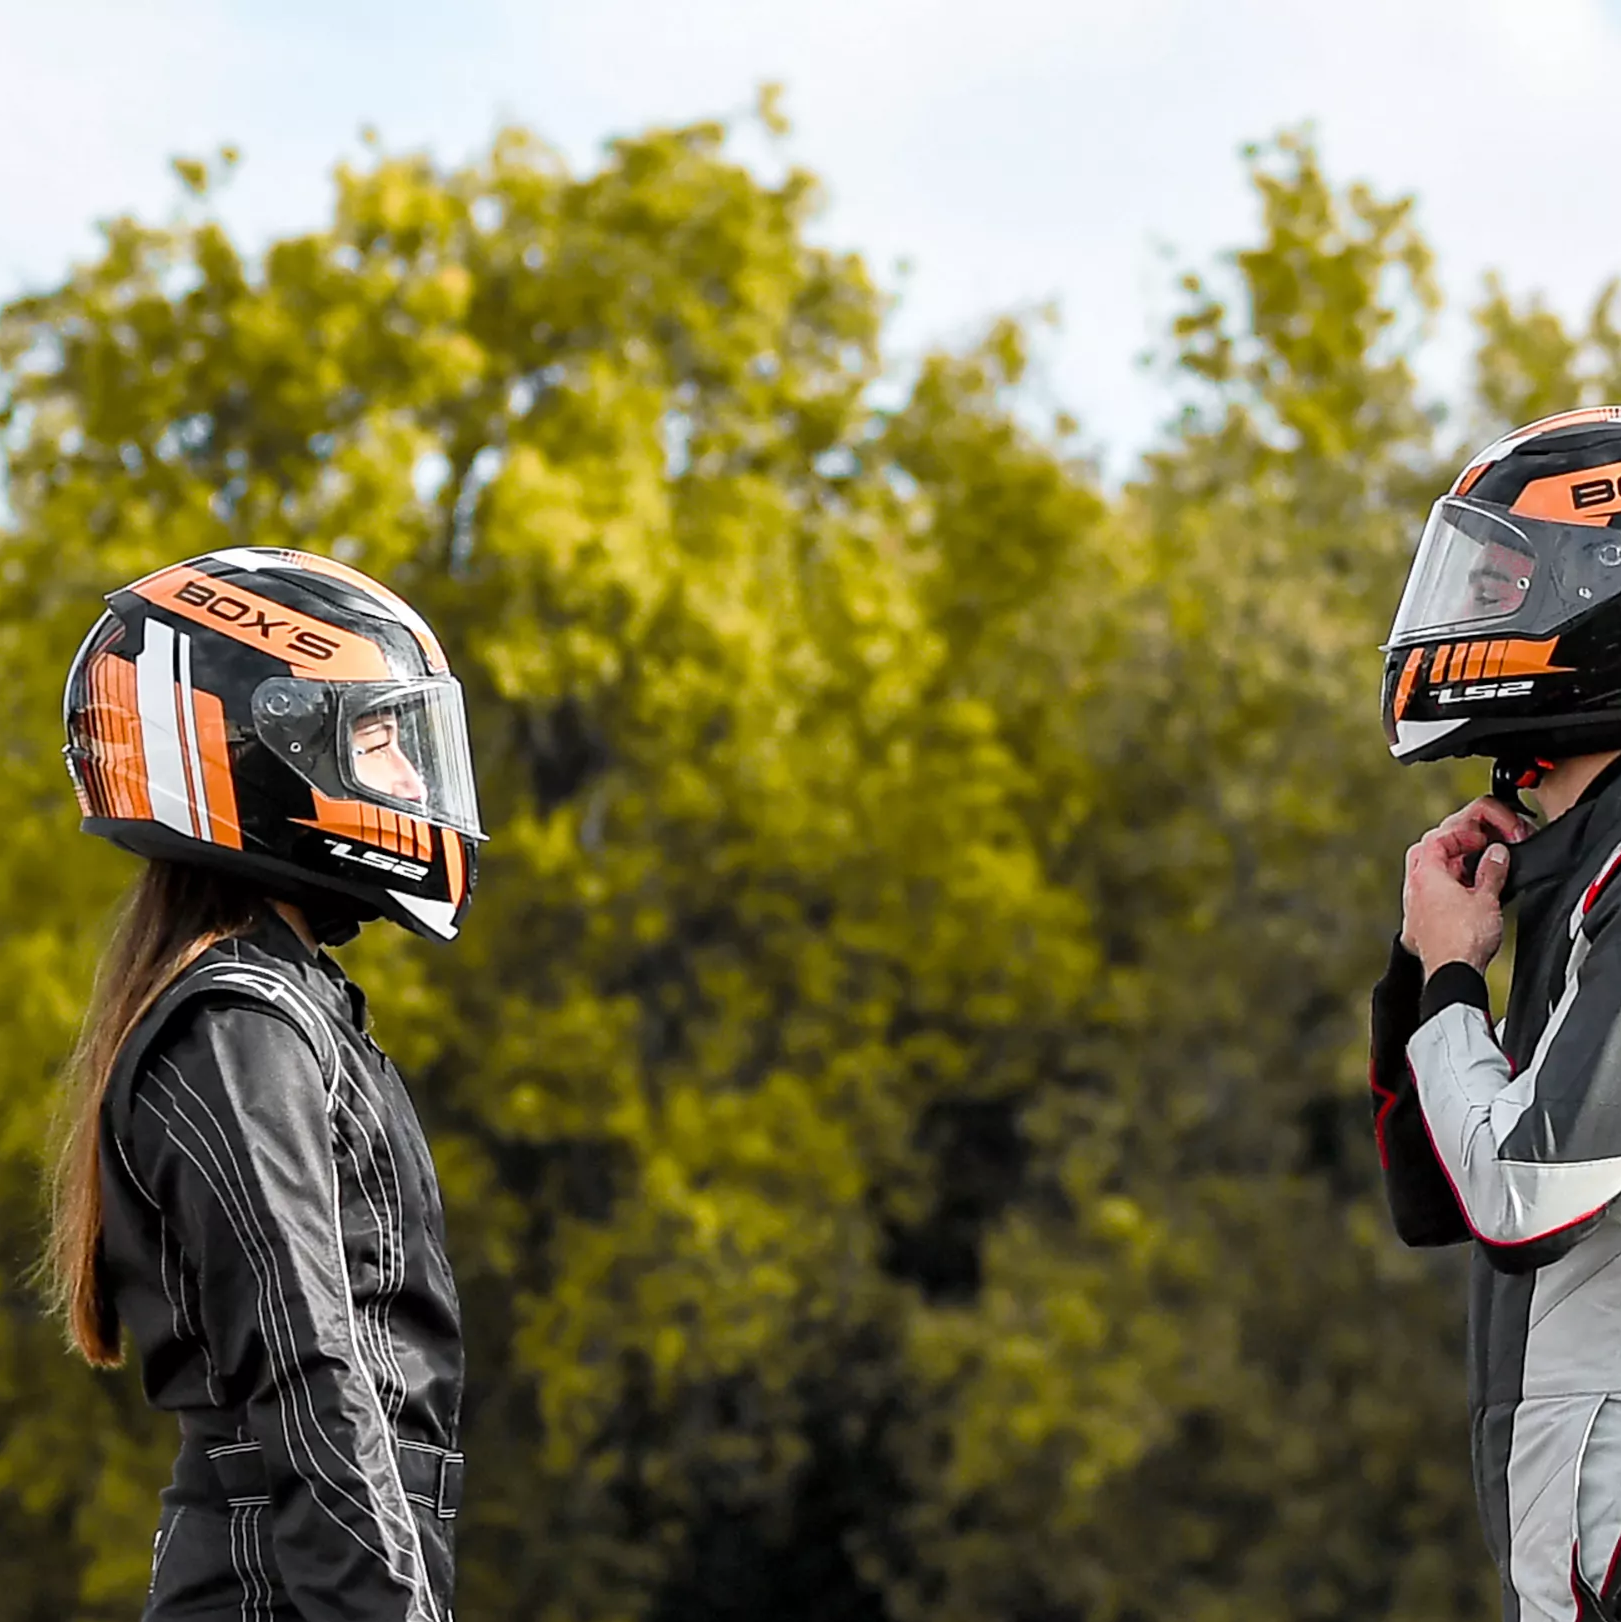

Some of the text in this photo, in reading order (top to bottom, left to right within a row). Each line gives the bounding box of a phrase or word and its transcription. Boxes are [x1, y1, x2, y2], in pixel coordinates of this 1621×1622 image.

[173, 581, 341, 660] BOX'S
[1429, 680, 1534, 704] LS2
[324, 839, 429, 881] LS2
